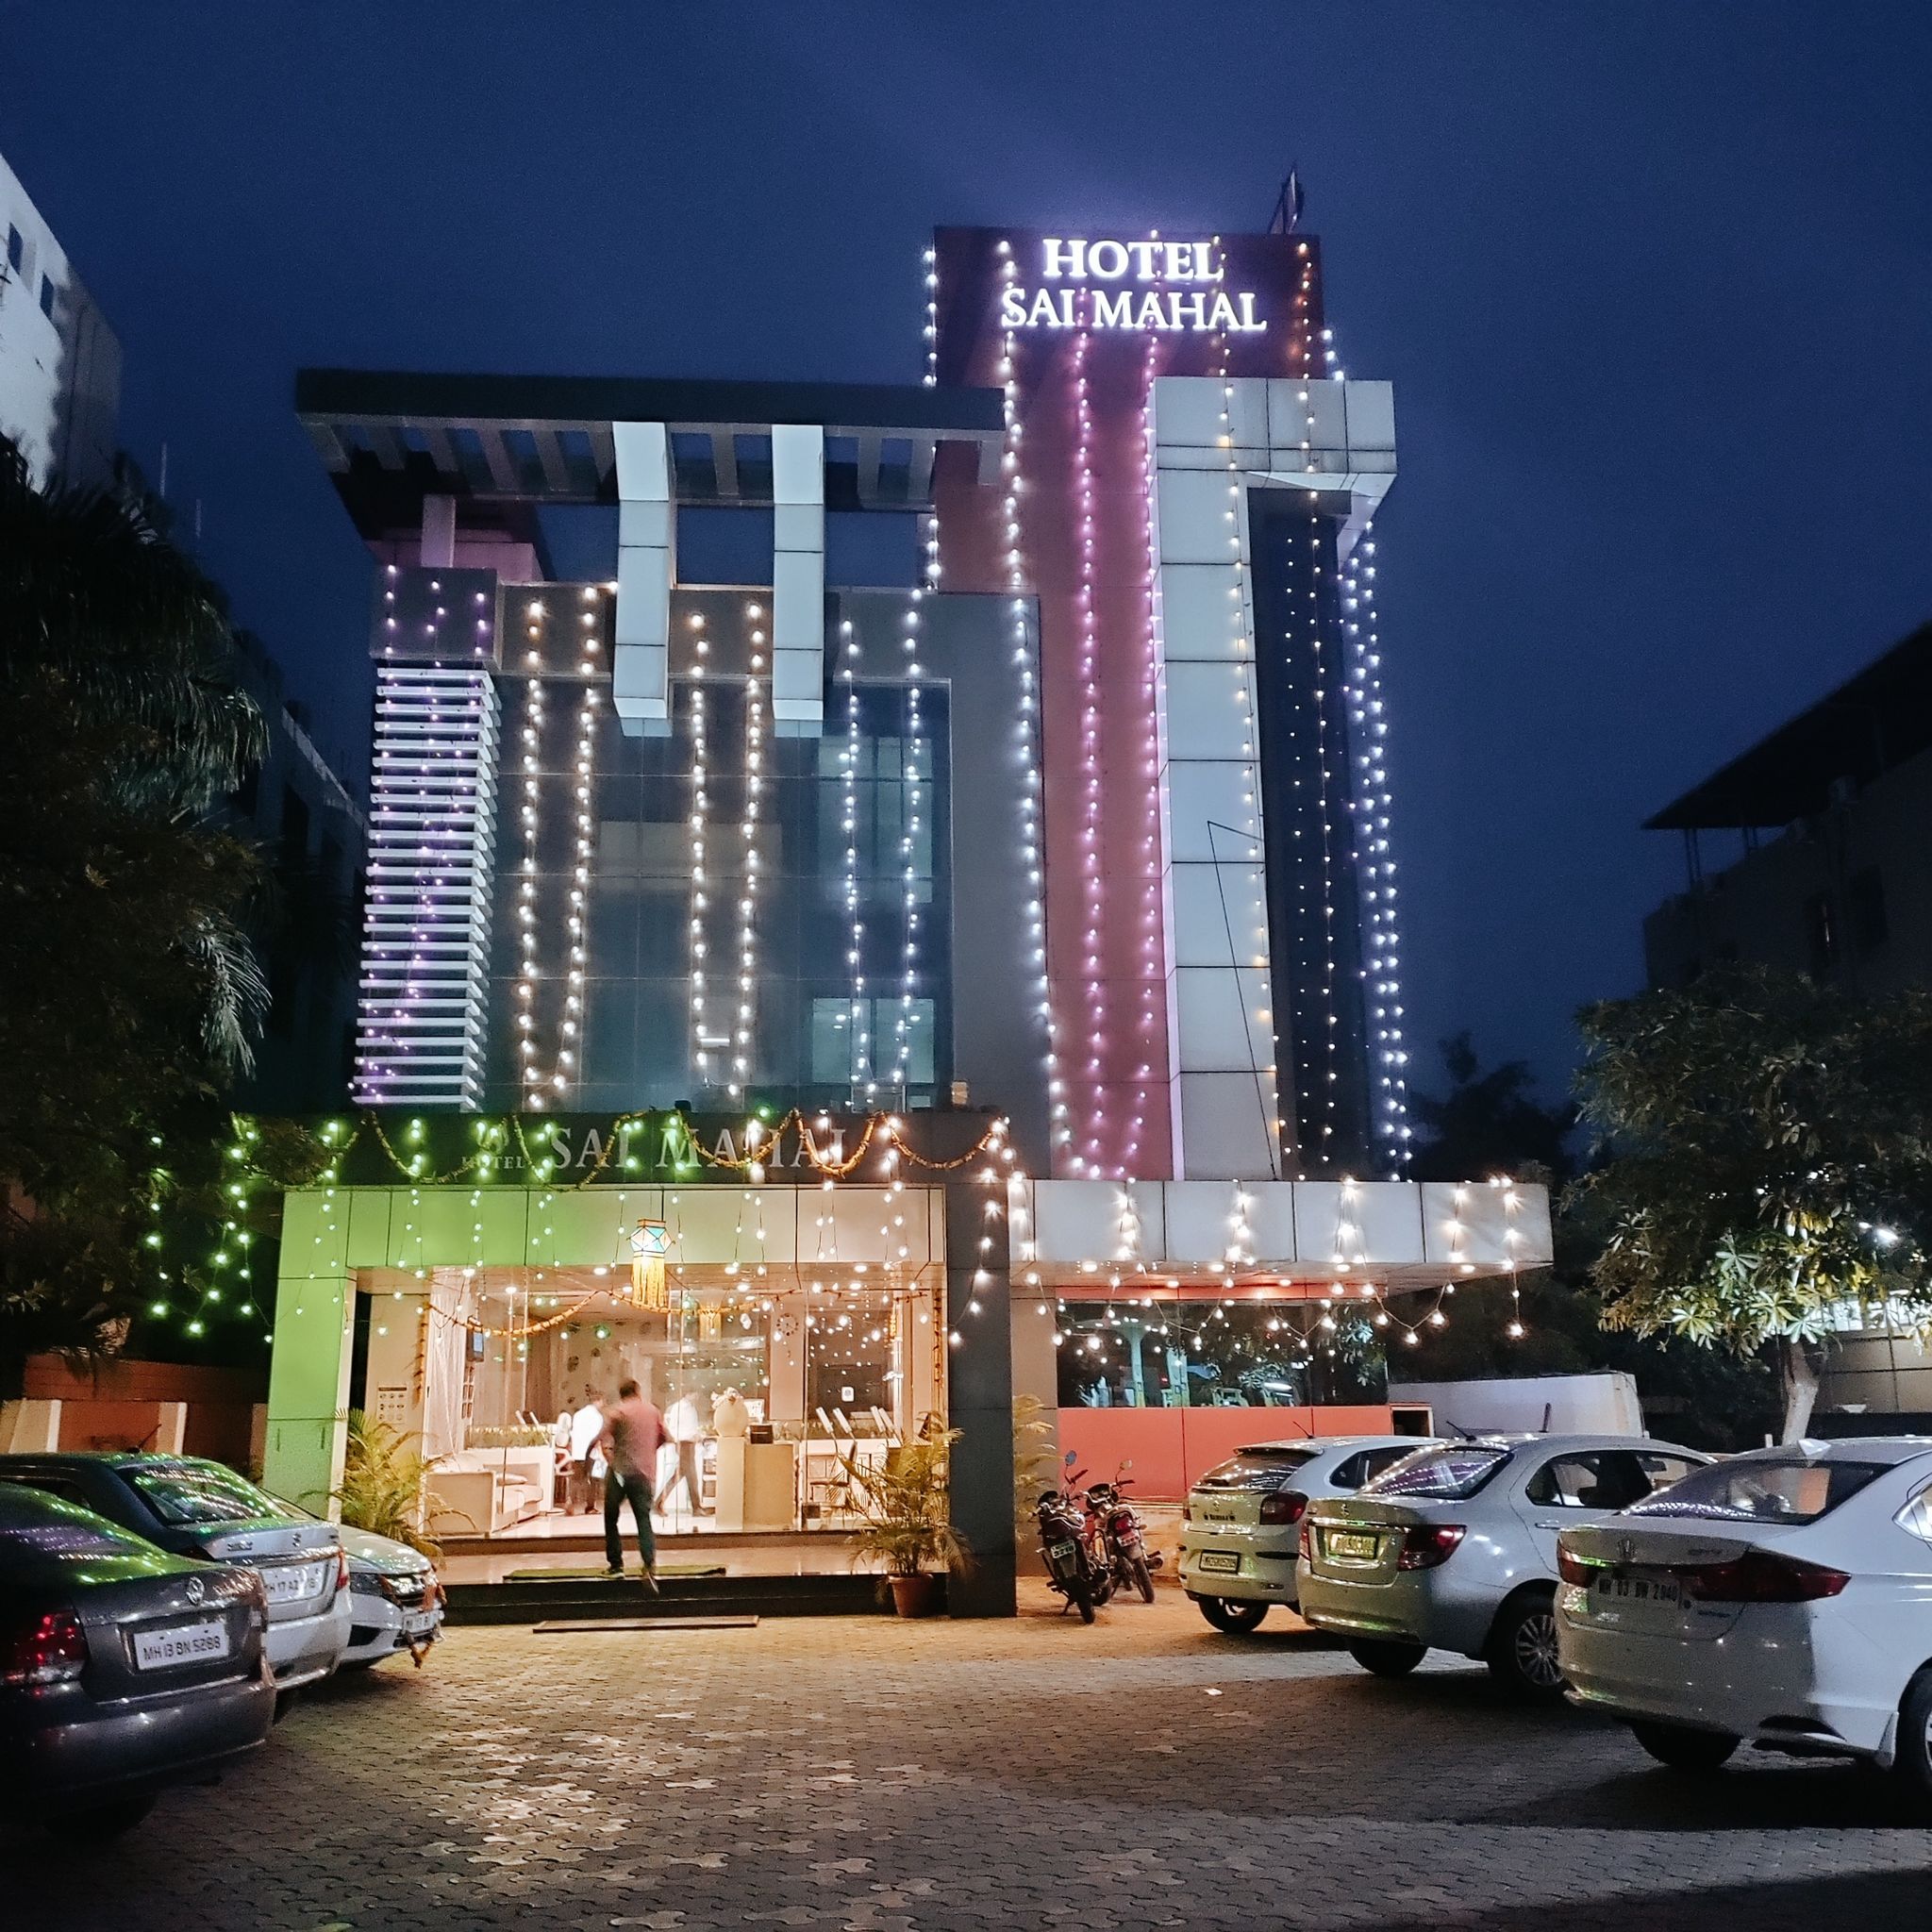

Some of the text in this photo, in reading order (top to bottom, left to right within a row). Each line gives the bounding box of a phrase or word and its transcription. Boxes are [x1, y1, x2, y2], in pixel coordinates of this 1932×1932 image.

[1042, 239, 1224, 280] HOTEL
[1001, 288, 1268, 330] SAI MAHAL
[461, 1156, 526, 1169] HTEL
[550, 1128, 631, 1169] SAI
